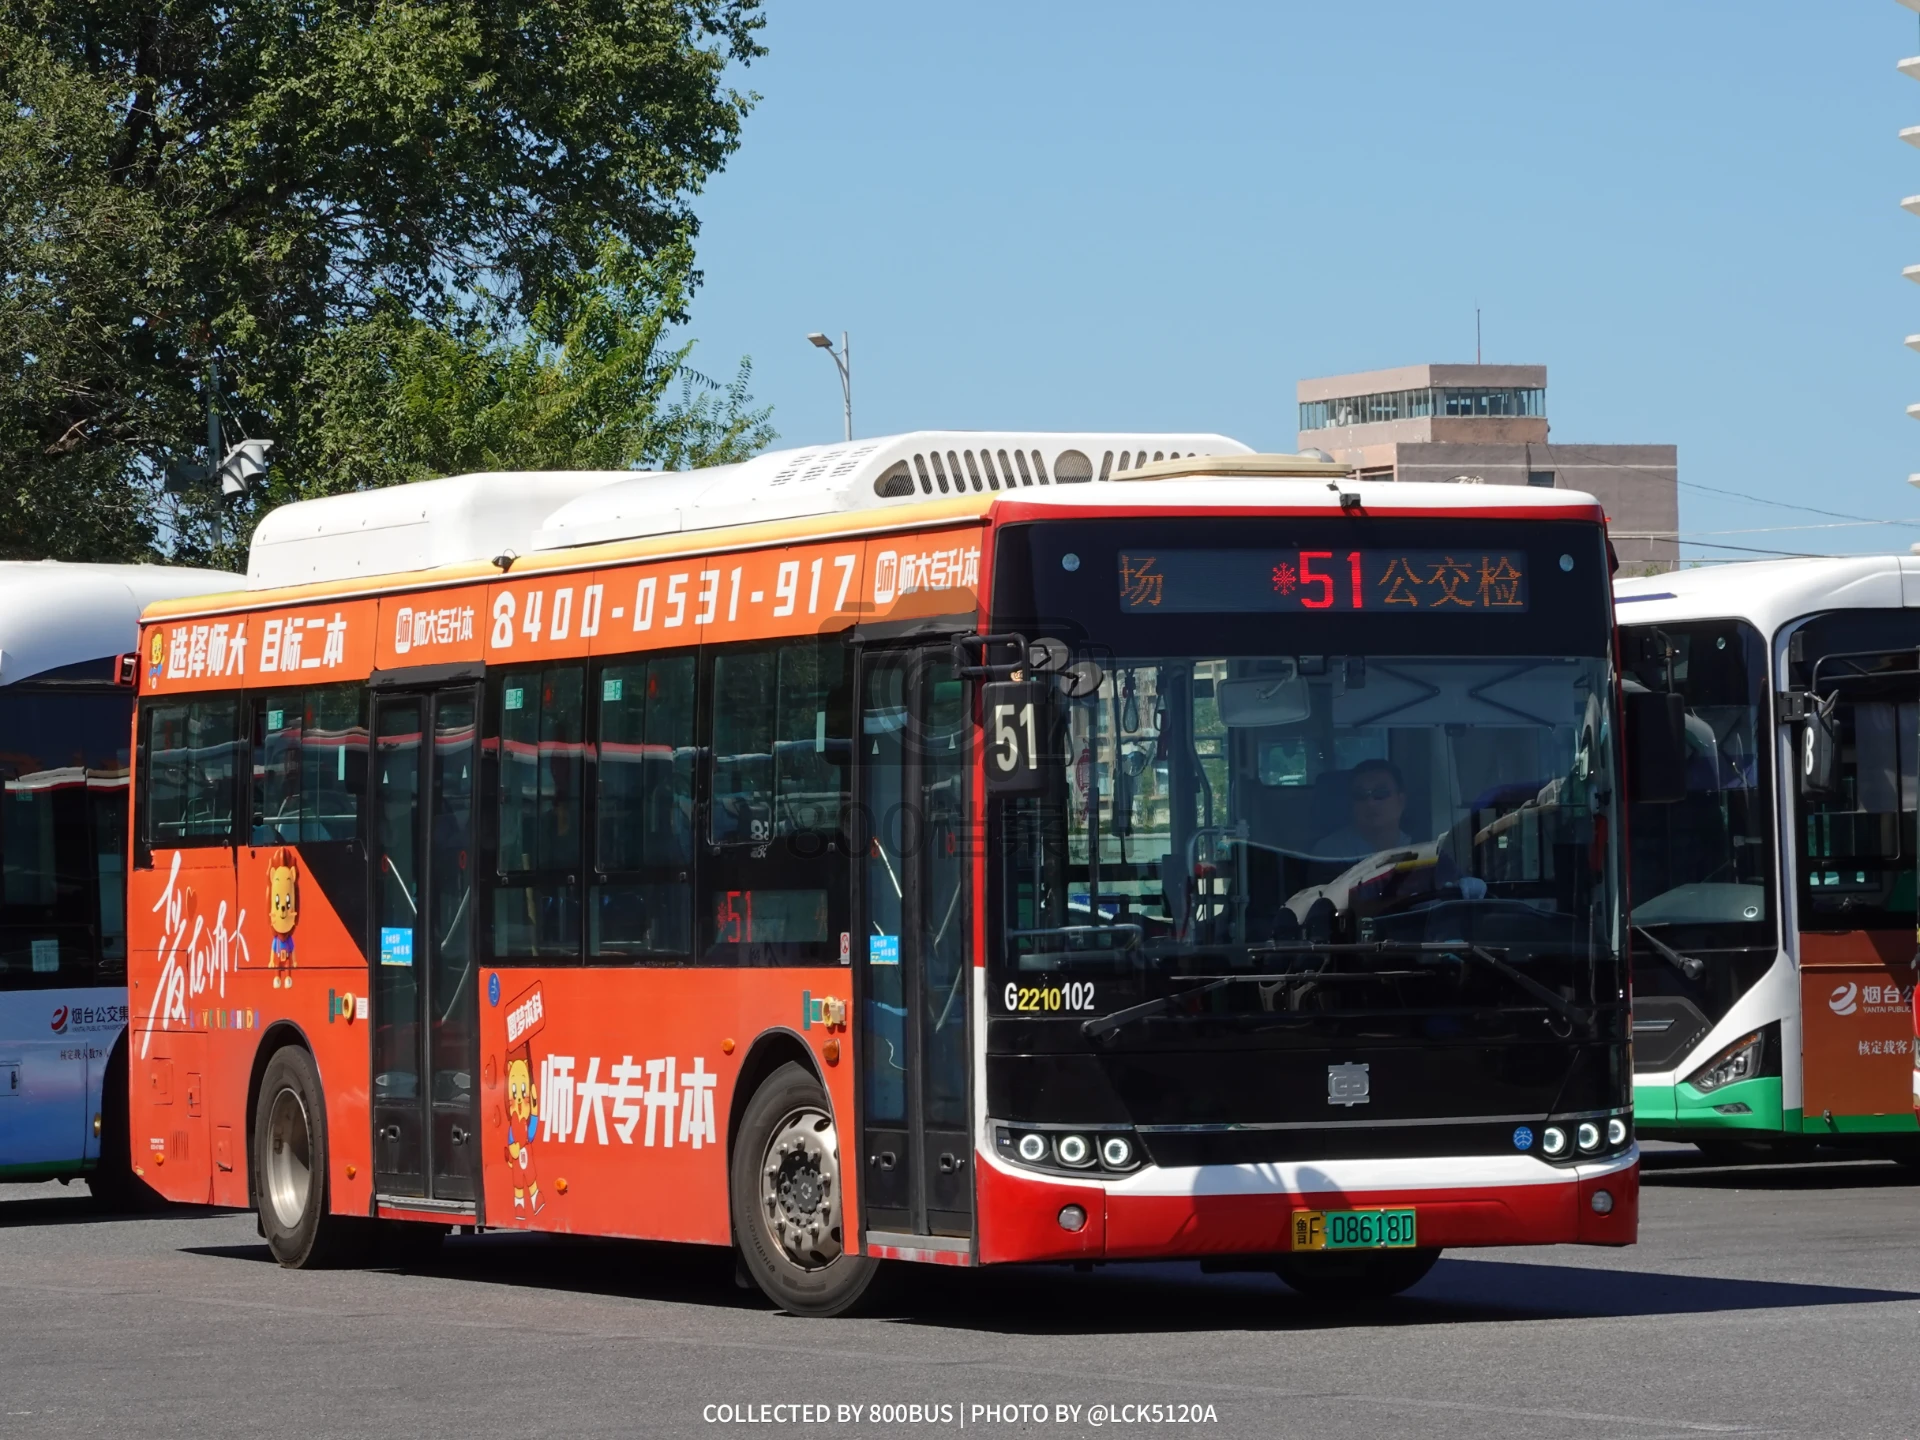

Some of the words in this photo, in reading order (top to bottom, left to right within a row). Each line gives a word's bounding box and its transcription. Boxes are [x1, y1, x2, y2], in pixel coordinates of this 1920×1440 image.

[1119, 554, 1165, 606] 场
[1299, 551, 1364, 608] 51
[1377, 556, 1524, 607] 公交检
[167, 622, 247, 679] 选择师大
[259, 612, 347, 673] 目标二本
[412, 605, 475, 647] 师大专升本
[994, 703, 1037, 772] 51
[726, 890, 752, 943] 51
[1004, 982, 1096, 1012] G2210102
[539, 1054, 717, 1149] 师大专升本
[1332, 1214, 1414, 1244] 08618D
